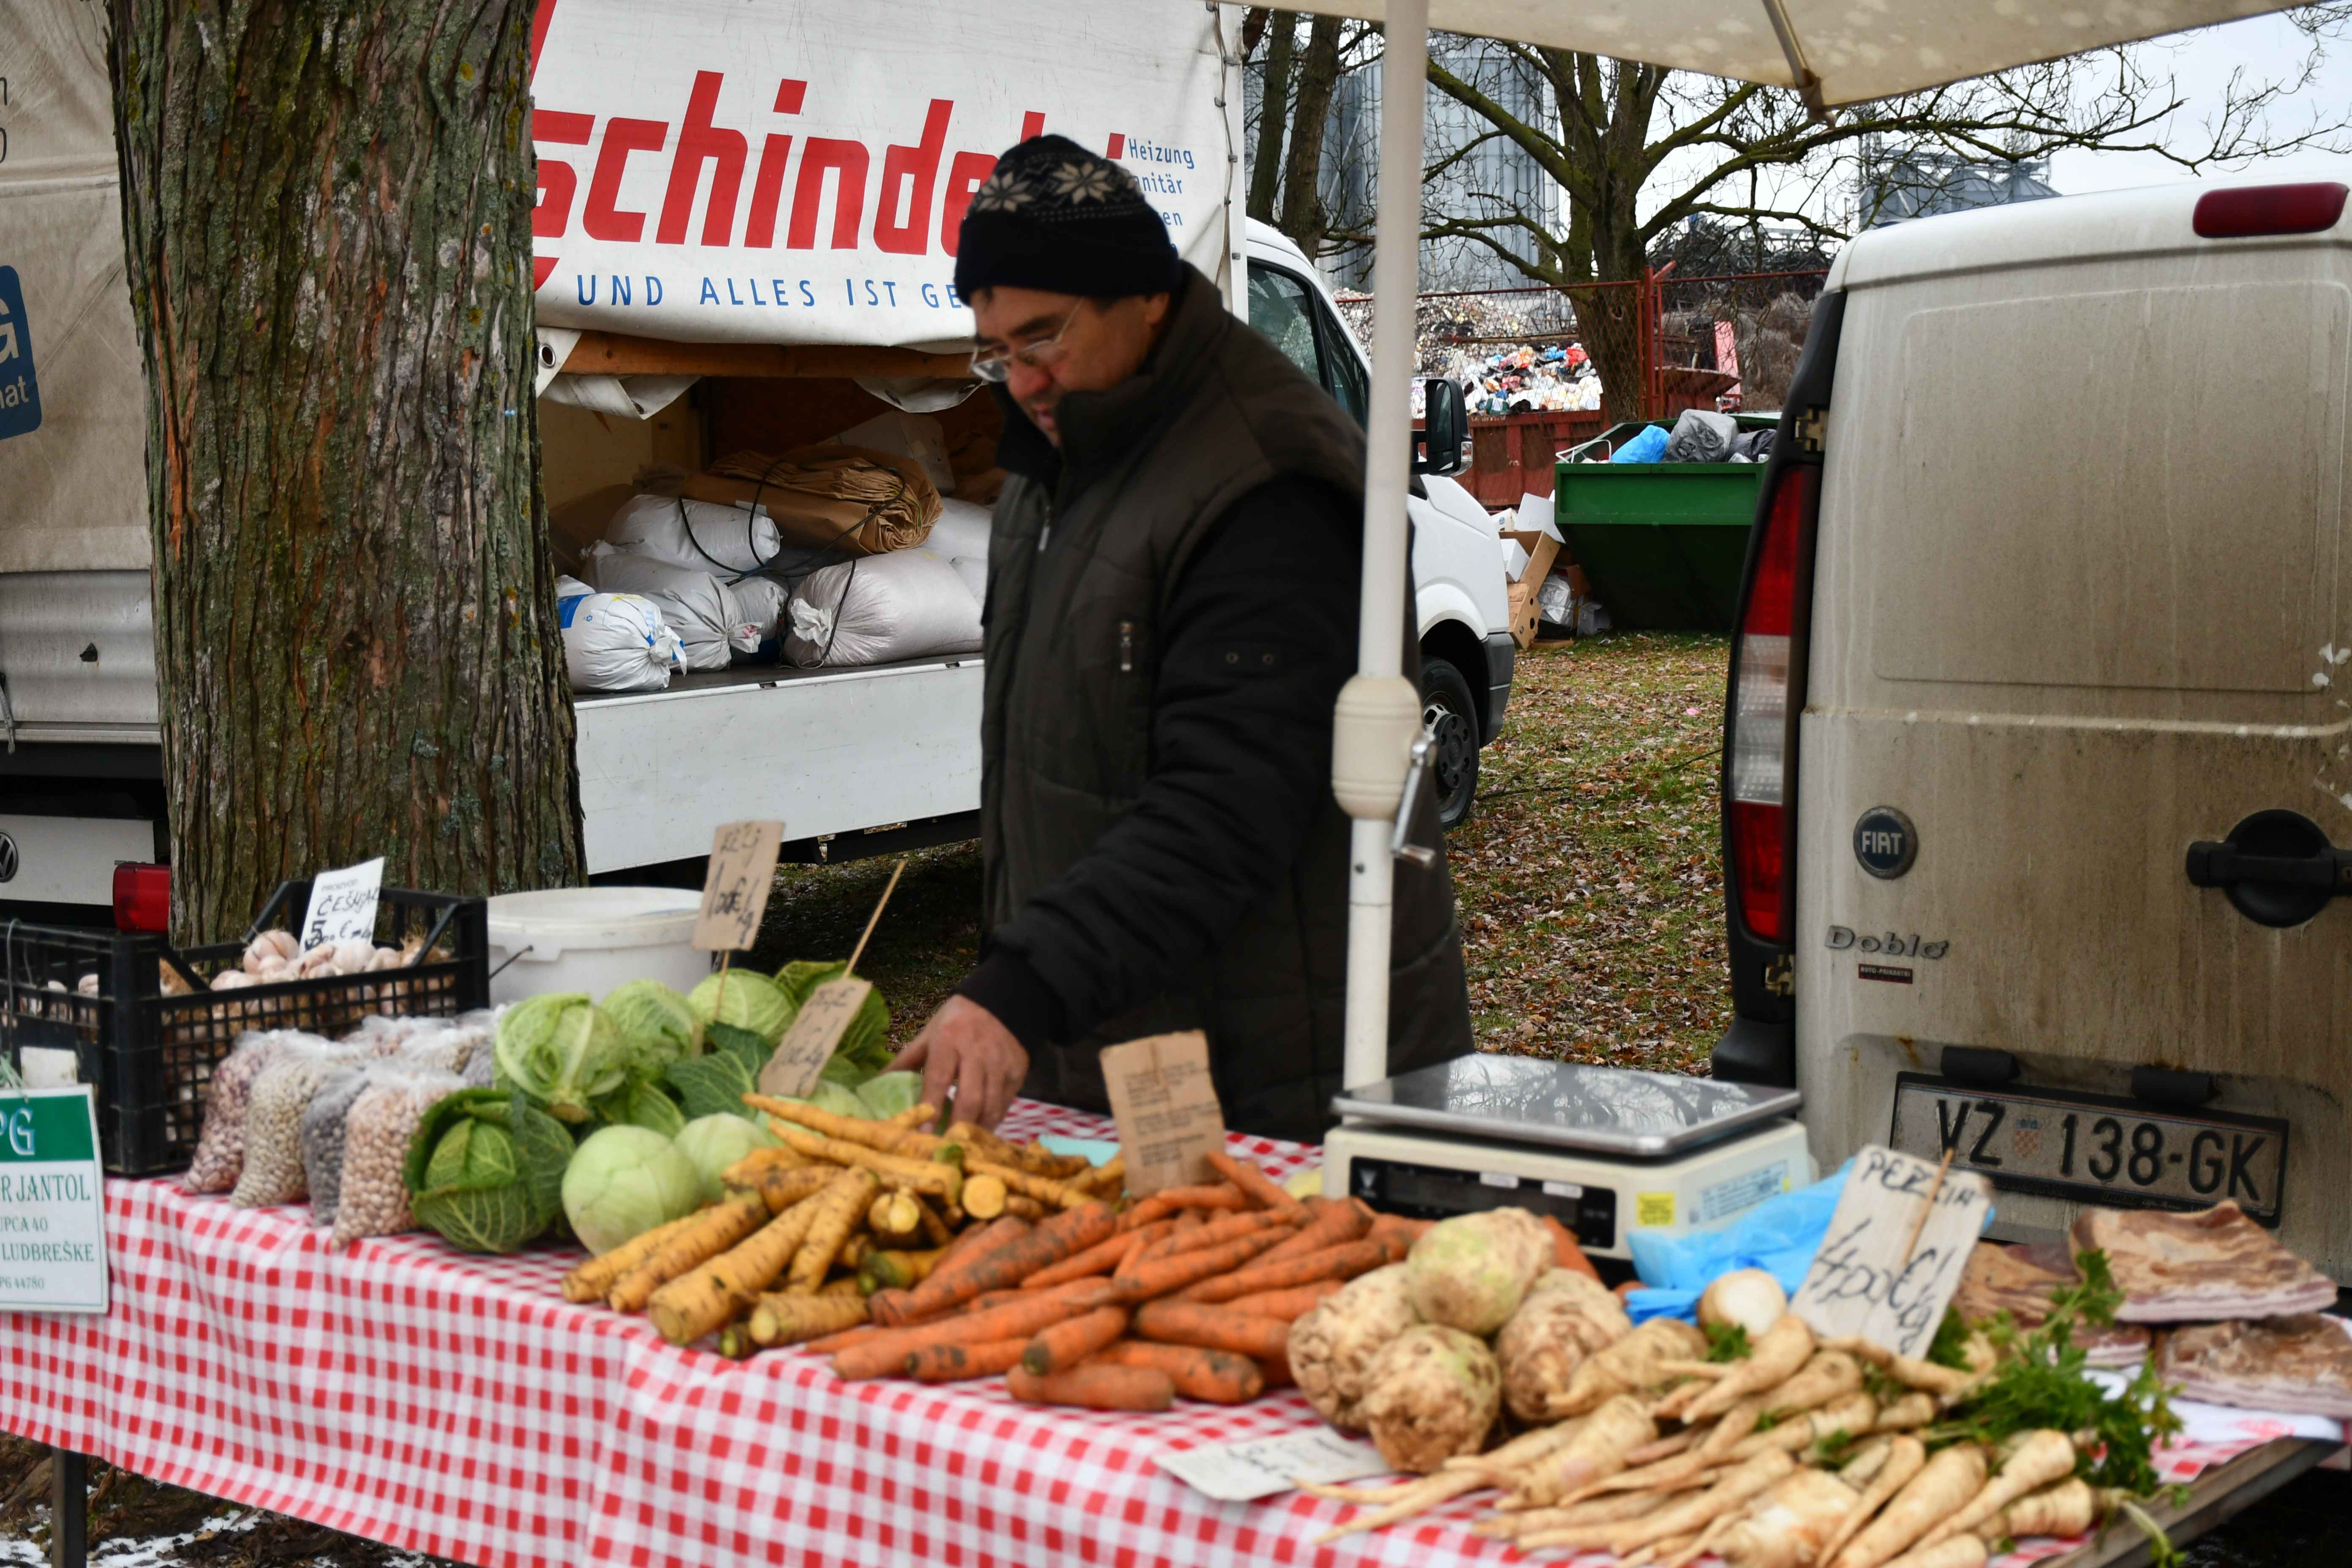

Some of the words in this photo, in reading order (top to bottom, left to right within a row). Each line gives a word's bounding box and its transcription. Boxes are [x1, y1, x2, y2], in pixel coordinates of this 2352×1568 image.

[1128, 139, 1194, 169] Heizung
[1132, 172, 1183, 194] anitär
[577, 275, 663, 305] UND
[700, 277, 815, 306] ALLES
[846, 279, 897, 307] IST
[922, 283, 962, 309] GE
[1862, 831, 1902, 854] FIAT
[2061, 1113, 2267, 1201] 138-GK
[16, 1174, 91, 1202] JANTOL
[32, 1217, 49, 1233] 40
[1, 1240, 95, 1262] LUDBREŠKE
